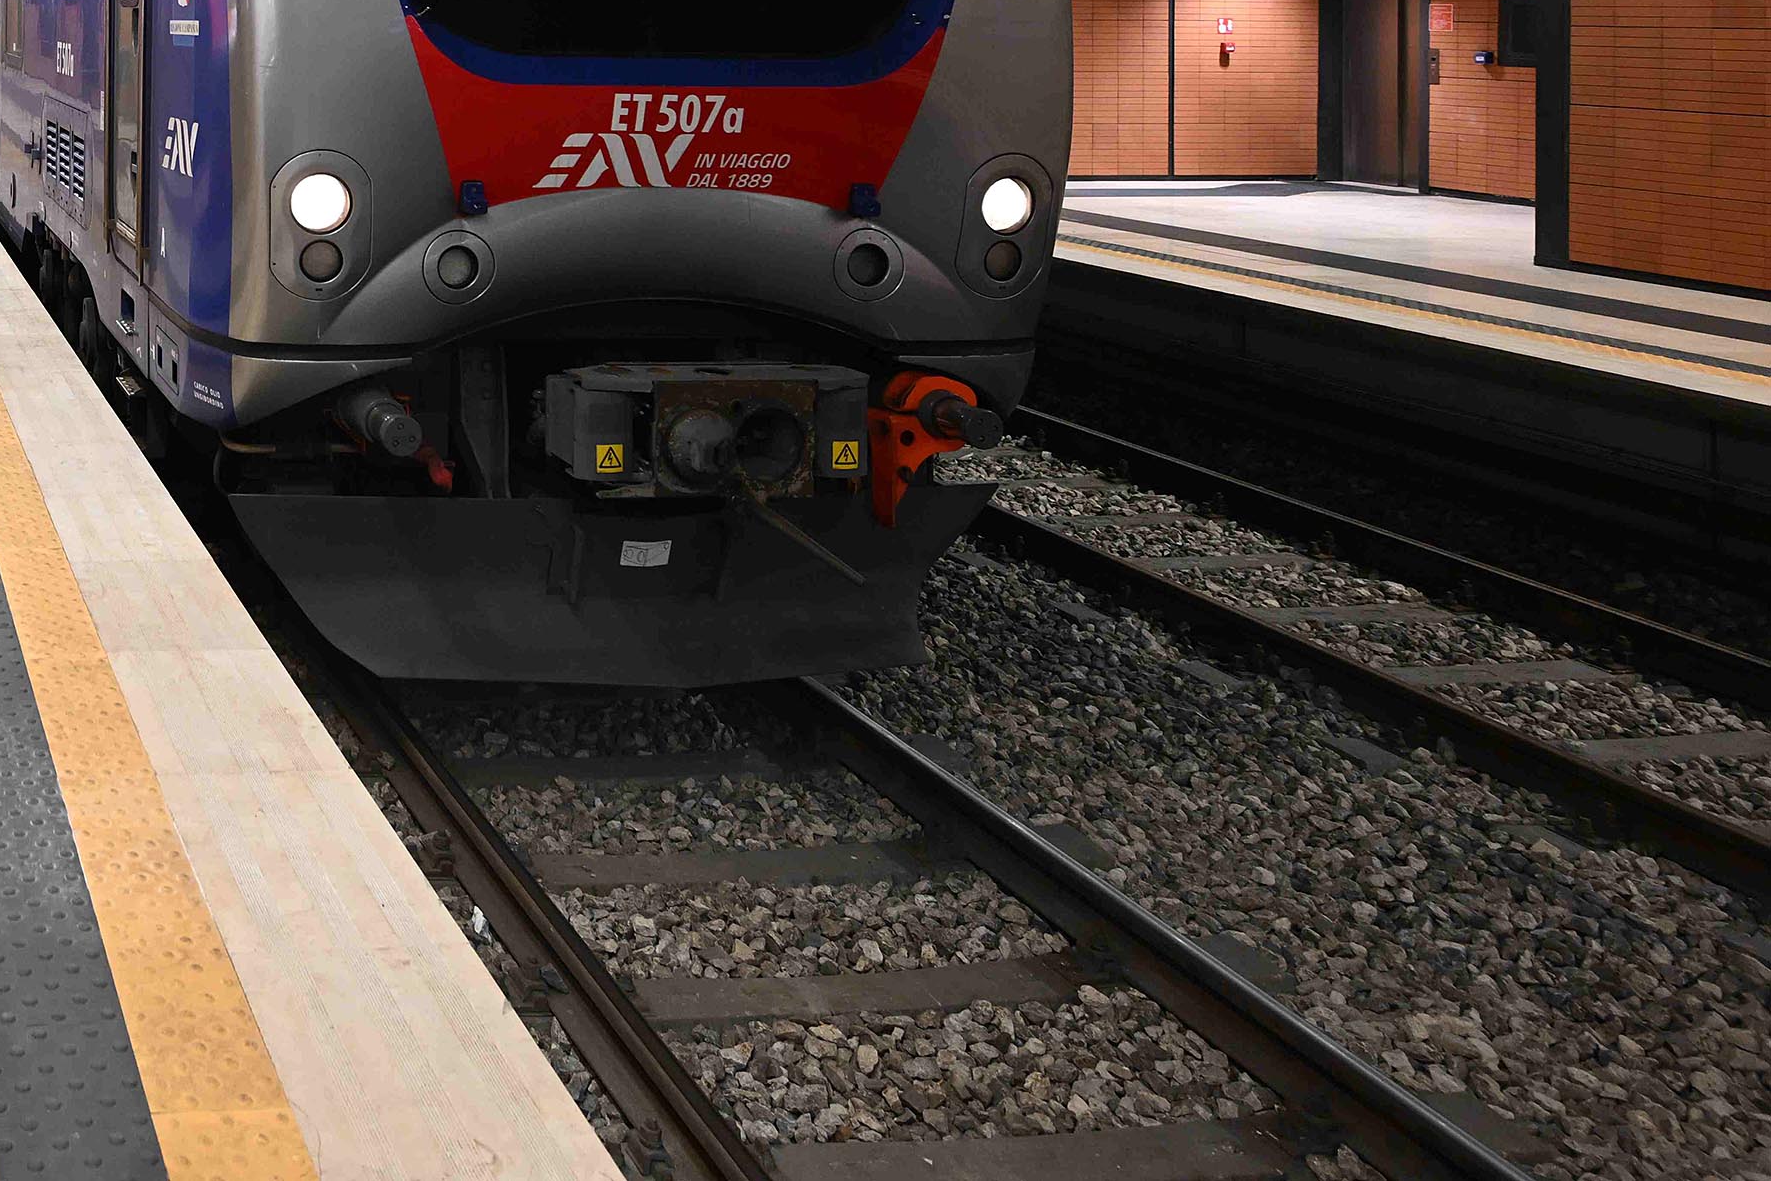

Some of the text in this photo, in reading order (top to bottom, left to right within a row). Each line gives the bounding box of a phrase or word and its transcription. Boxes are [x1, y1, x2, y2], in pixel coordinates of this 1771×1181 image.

[611, 93, 745, 134] ET 507a
[532, 132, 696, 189] EAV
[694, 153, 791, 169] IN VIAGGIO
[685, 173, 774, 188] DAL 1889
